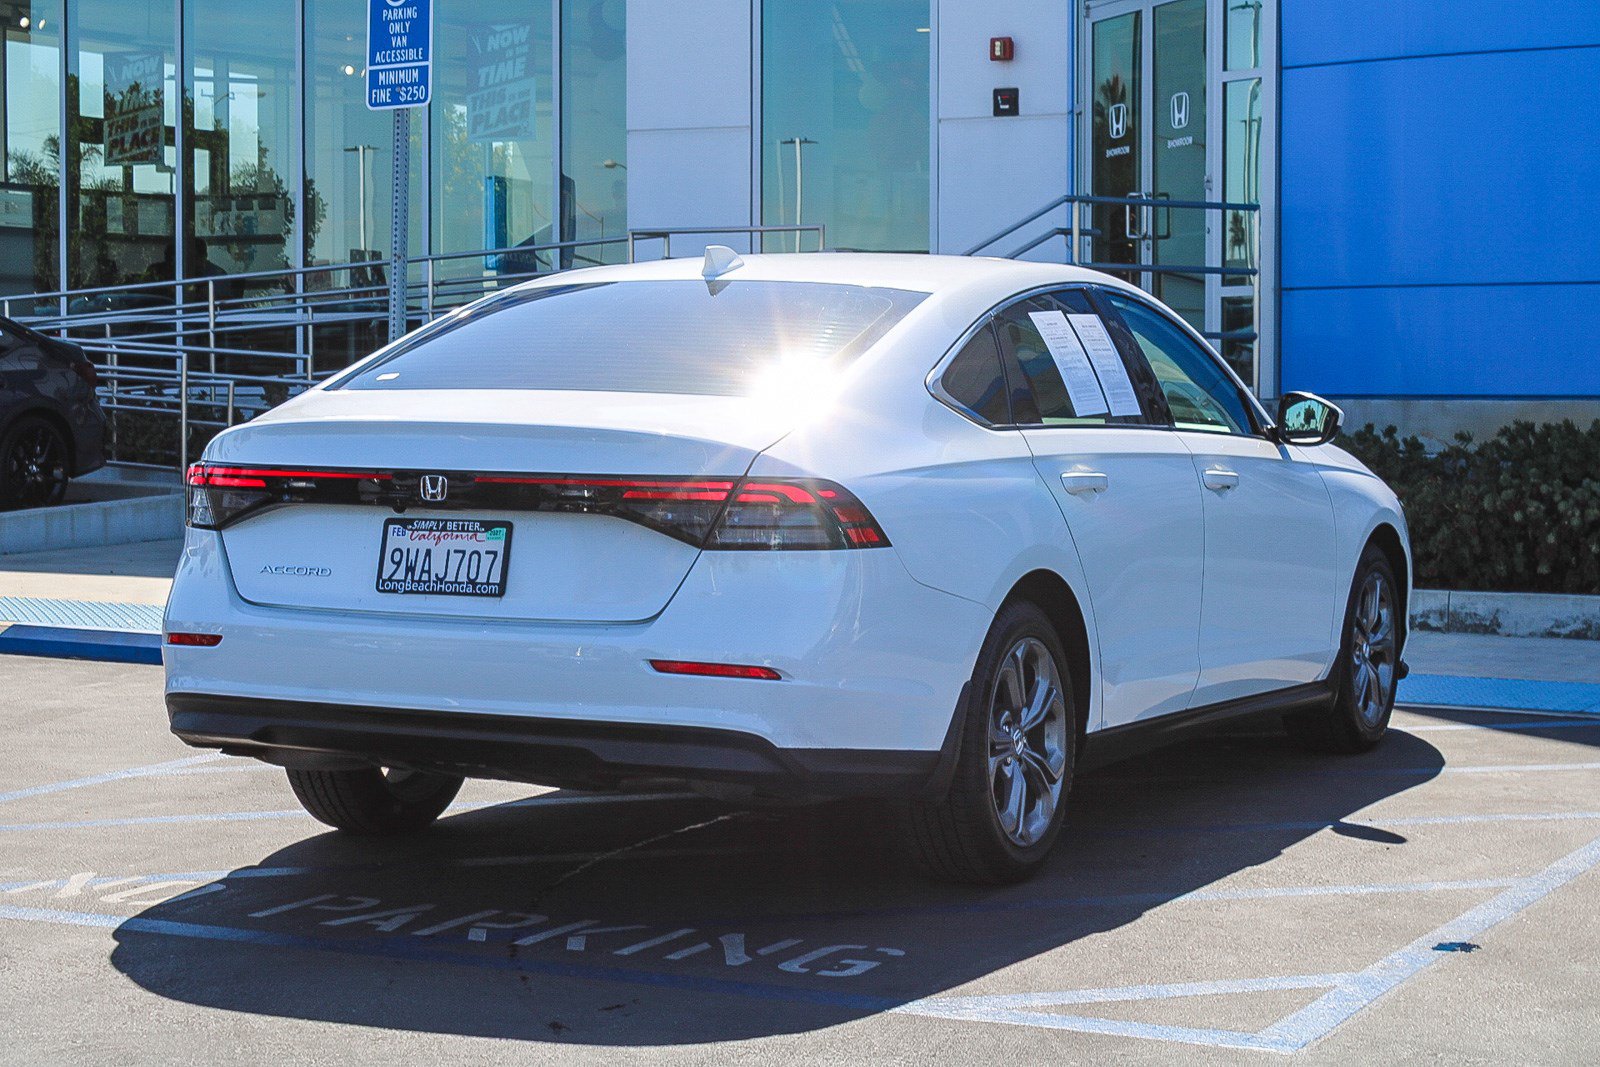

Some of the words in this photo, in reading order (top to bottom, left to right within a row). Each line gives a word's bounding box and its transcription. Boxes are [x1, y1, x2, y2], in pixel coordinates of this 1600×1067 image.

[382, 6, 418, 21] PARKING
[389, 21, 410, 35] ONLY
[391, 35, 407, 48] VAN
[487, 25, 530, 53] NOW
[375, 47, 423, 63] ACCESSIBLE
[378, 68, 419, 86] MINIMUM
[478, 56, 526, 87] TIME
[372, 88, 392, 104] FINE
[399, 85, 426, 102] $250
[411, 520, 446, 531] SIMPLY
[447, 521, 481, 532] BETTER
[409, 530, 485, 547] California
[257, 565, 332, 577] ACCORD
[388, 547, 498, 583] 9WAJ707
[378, 578, 499, 595] LongBeachHonda.com
[248, 893, 906, 978] PARKING
